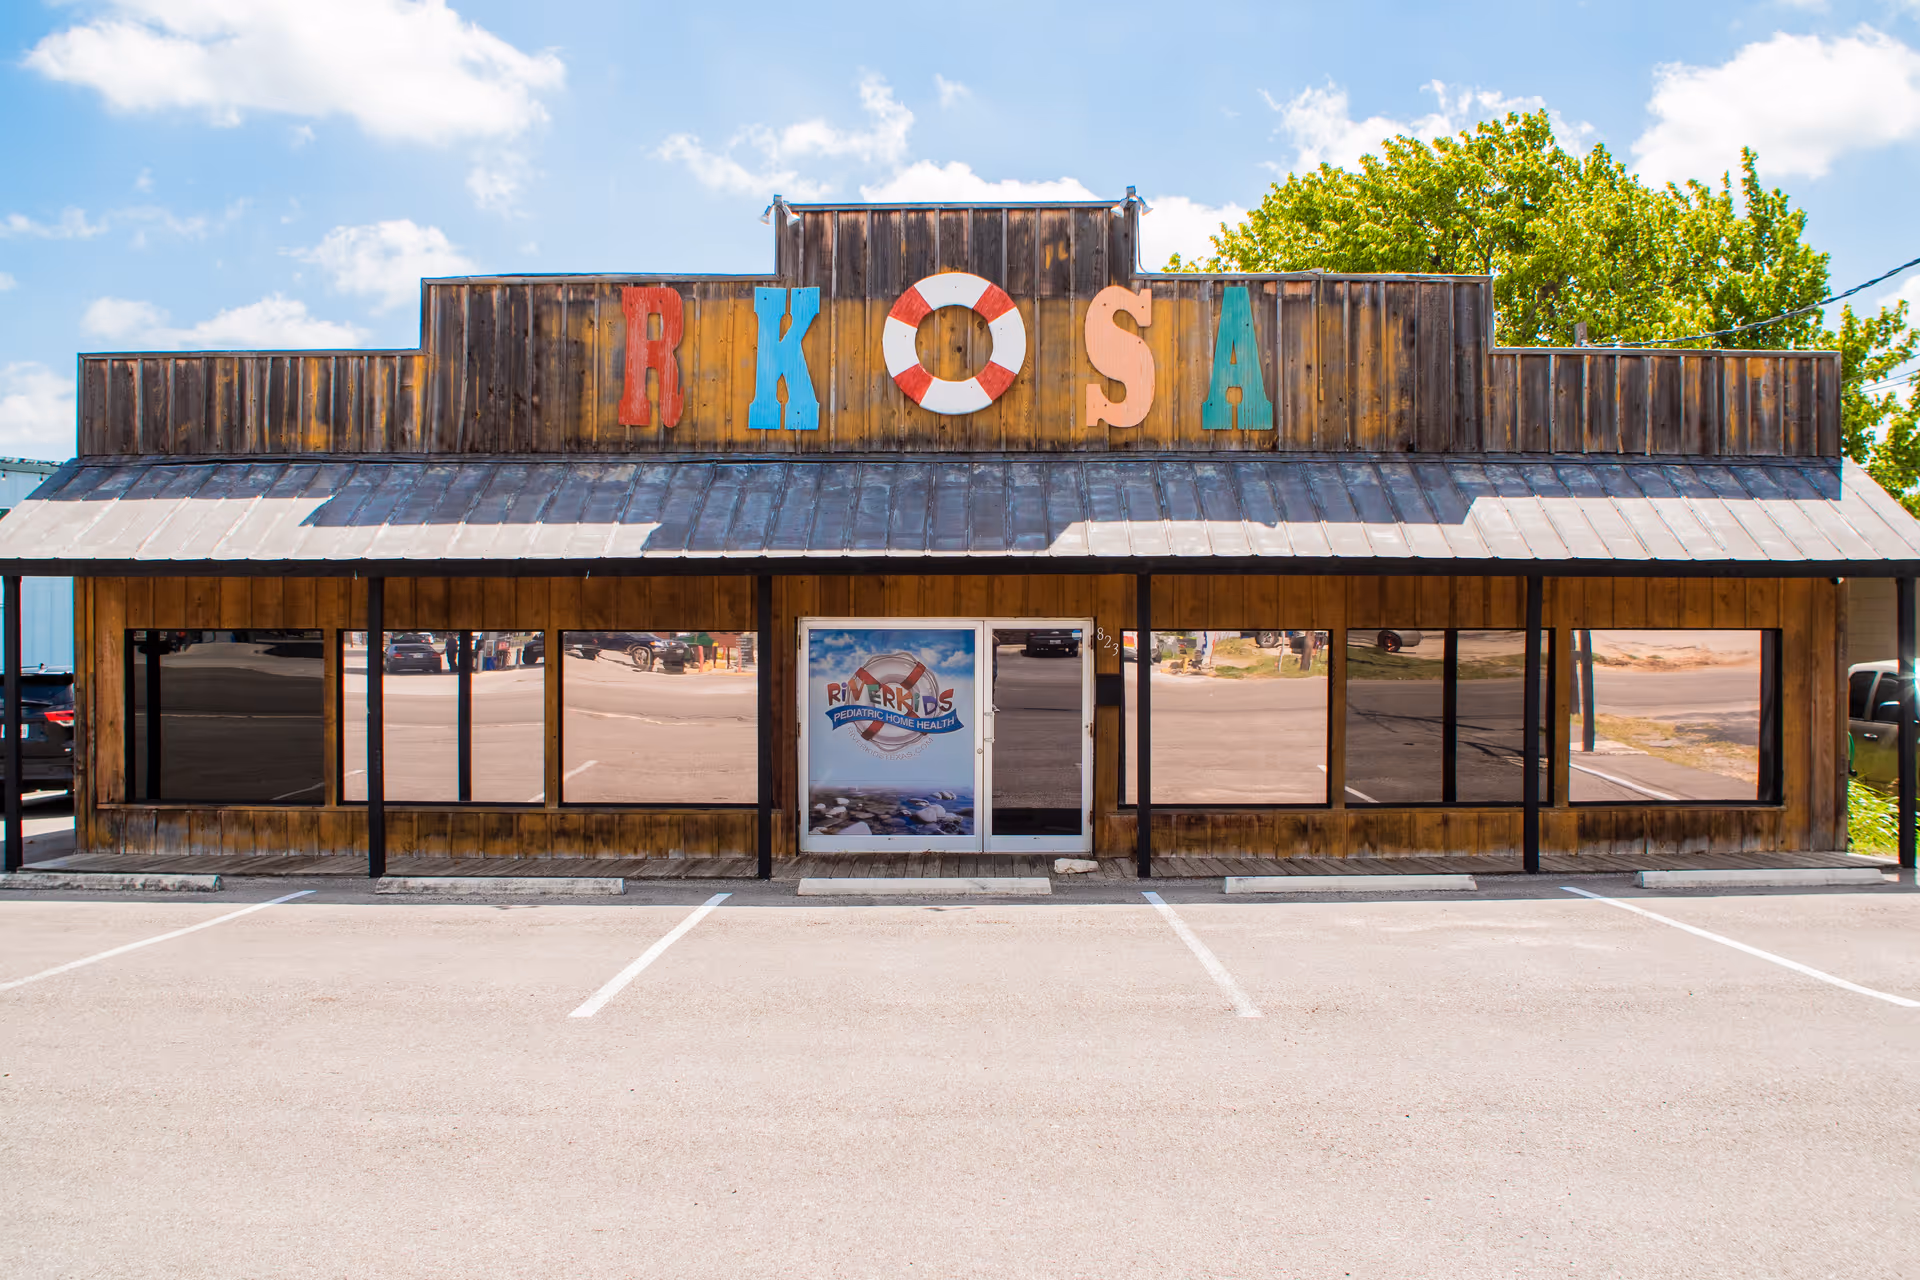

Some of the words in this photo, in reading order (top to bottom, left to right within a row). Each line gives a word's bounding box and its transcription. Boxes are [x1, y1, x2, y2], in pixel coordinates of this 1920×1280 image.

[1097, 627, 1119, 656] 823
[833, 707, 884, 723] PEDIATRIC
[885, 713, 915, 729] HOME
[916, 715, 955, 730] HEALTH
